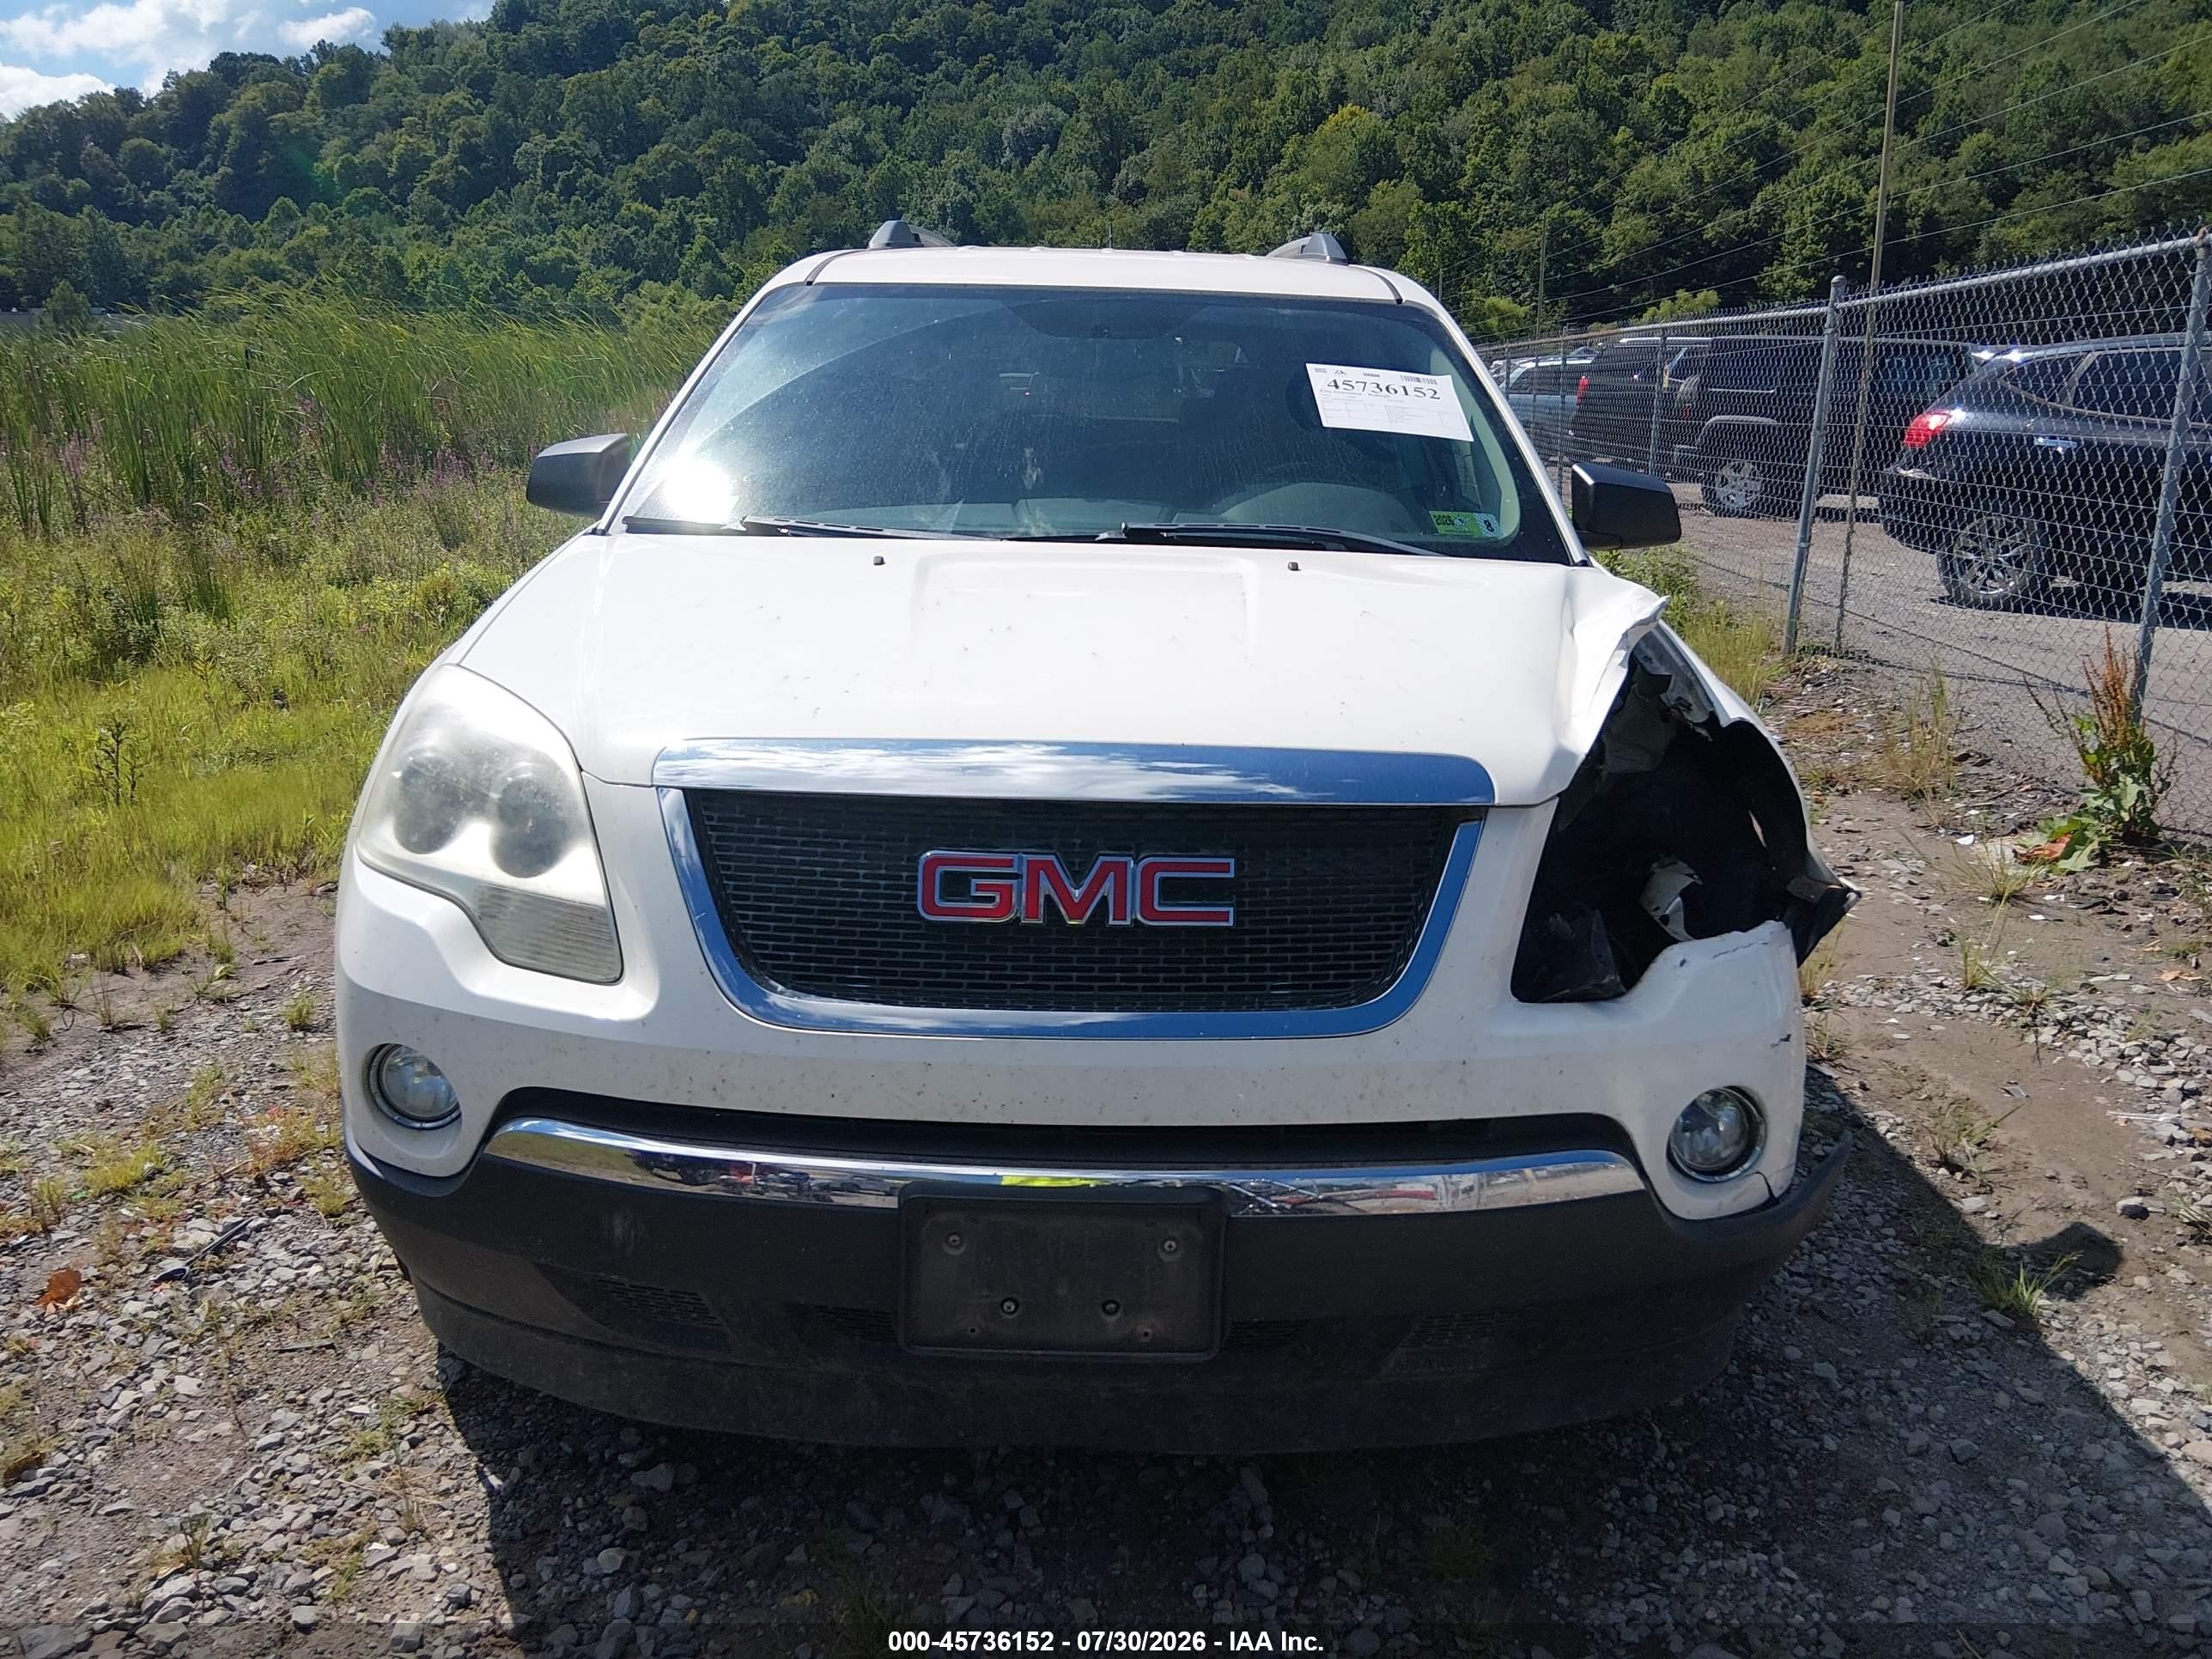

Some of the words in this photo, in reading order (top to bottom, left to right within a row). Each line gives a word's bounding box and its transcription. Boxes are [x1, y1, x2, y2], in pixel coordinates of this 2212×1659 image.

[1328, 379, 1441, 400] 45736152
[1483, 520, 1495, 532] 8
[916, 849, 1236, 927] GMC
